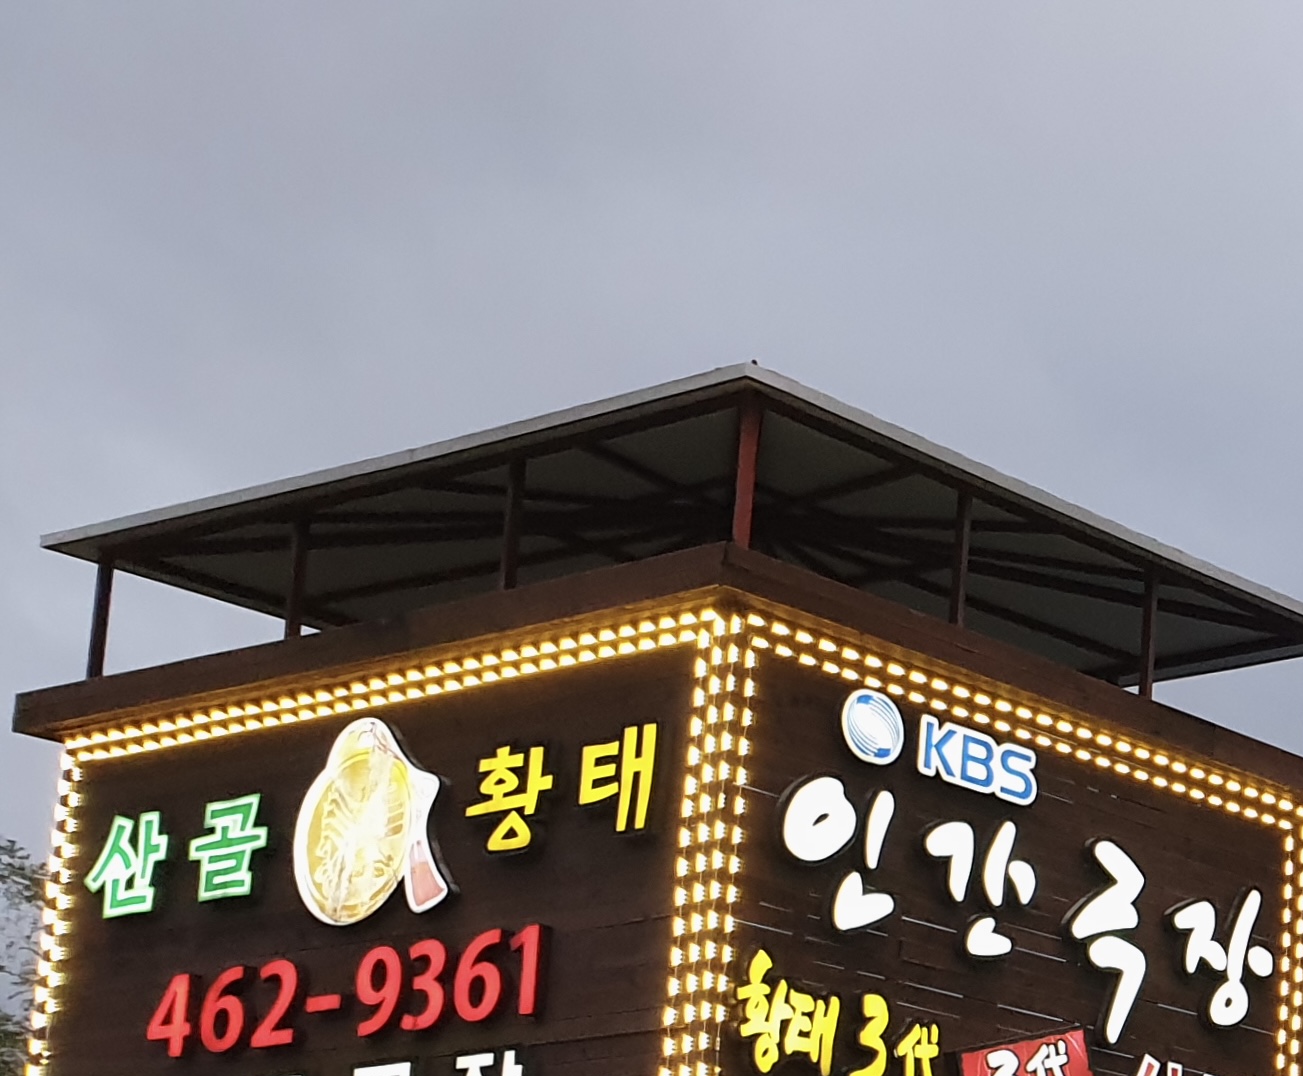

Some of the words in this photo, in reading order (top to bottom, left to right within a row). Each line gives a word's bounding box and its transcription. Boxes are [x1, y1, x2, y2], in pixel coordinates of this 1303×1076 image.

[85, 793, 268, 919] 산골
[464, 723, 658, 852] 황태
[917, 713, 1038, 806] KBS
[145, 924, 543, 1057] 462-9361
[782, 775, 1274, 1045] 인간극장
